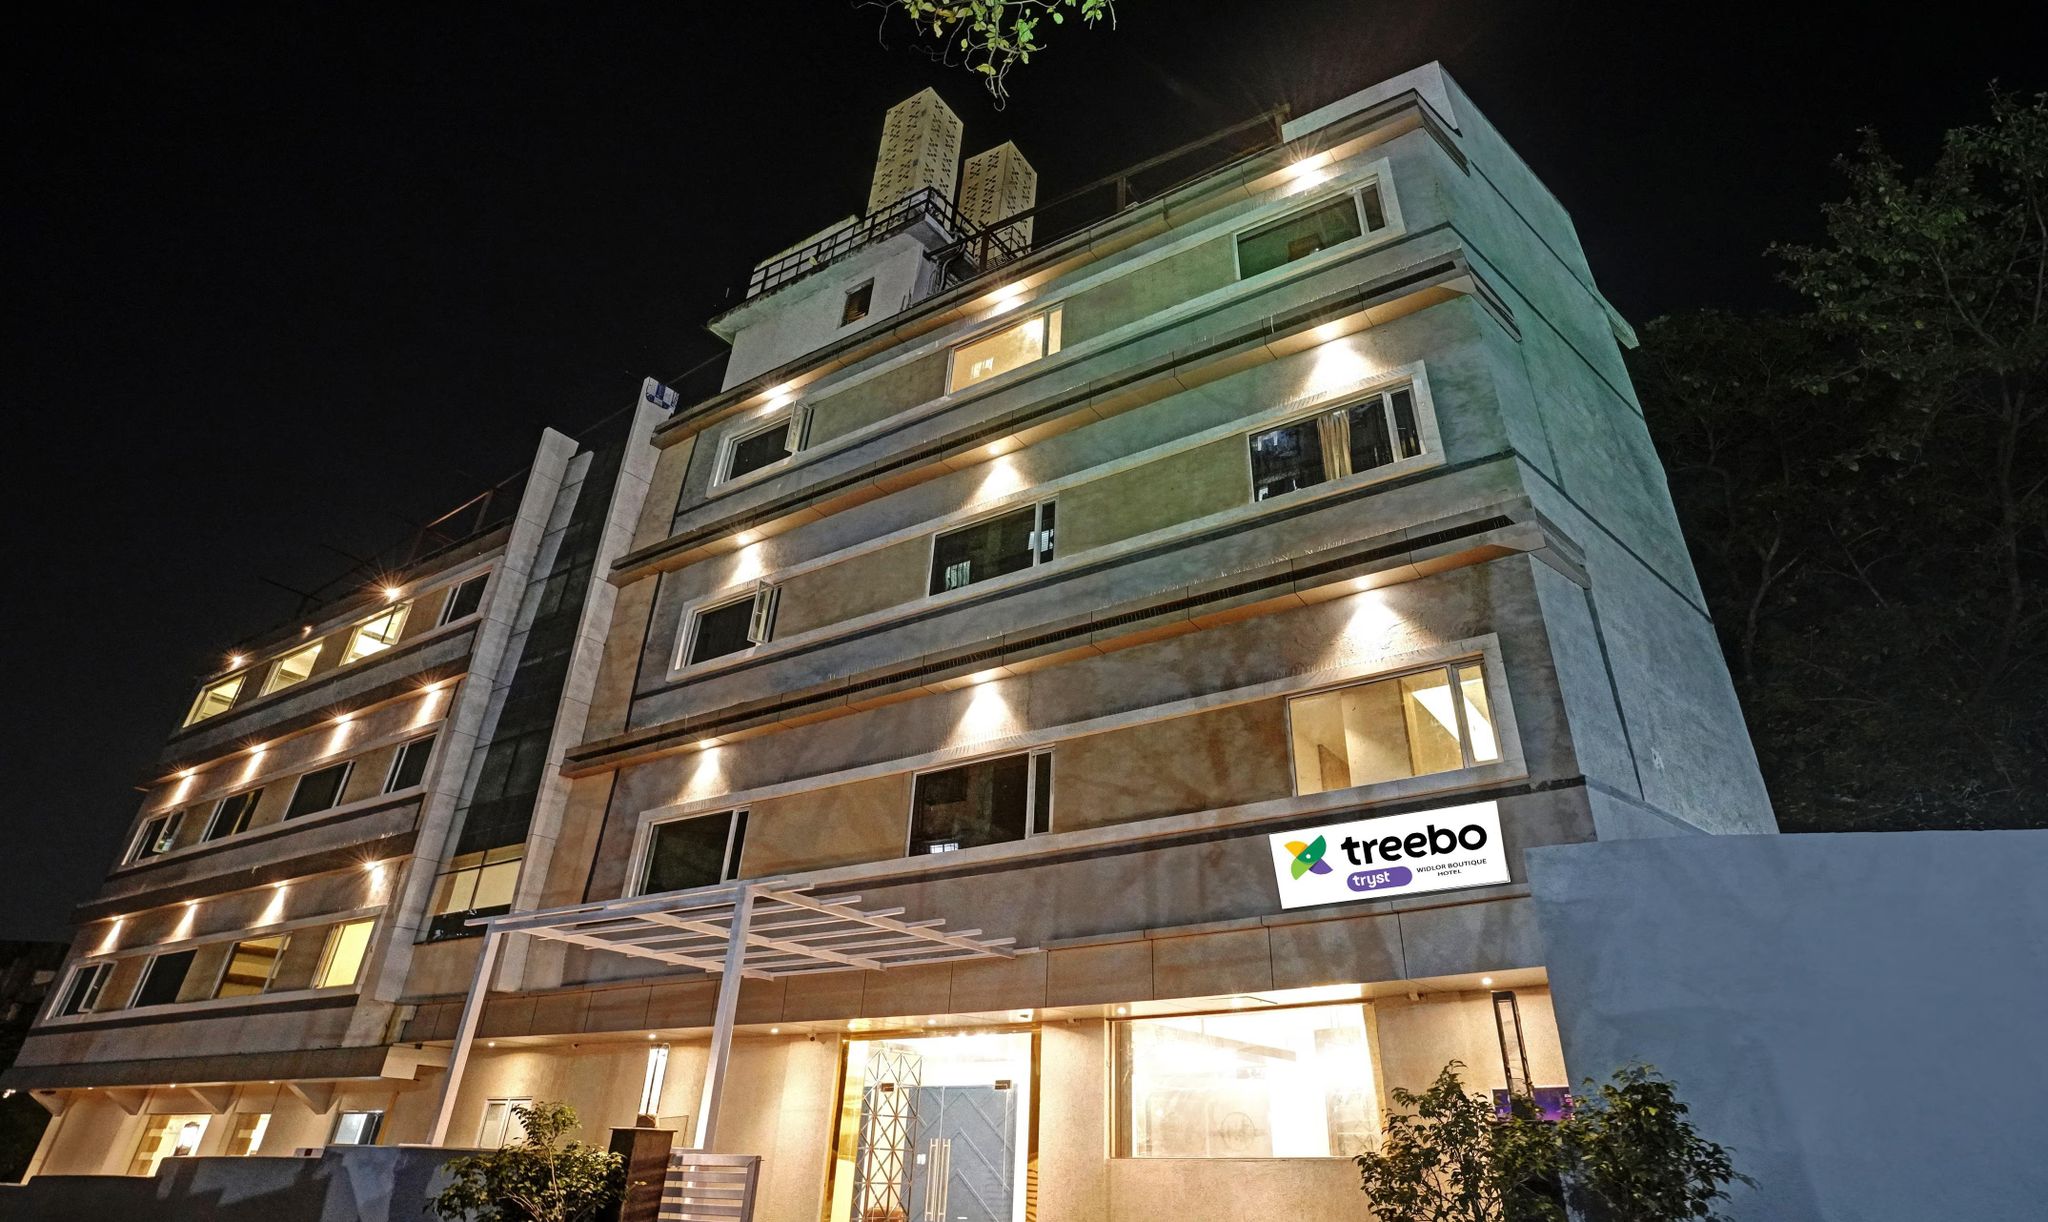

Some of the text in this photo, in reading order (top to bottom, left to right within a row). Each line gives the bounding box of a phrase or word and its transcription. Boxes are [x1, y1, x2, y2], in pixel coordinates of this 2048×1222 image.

[1341, 824, 1487, 865] treebo
[1416, 858, 1487, 873] WIDLOR BOUTIQUE
[1437, 869, 1462, 877] HOTEL
[1352, 870, 1390, 888] tryst
